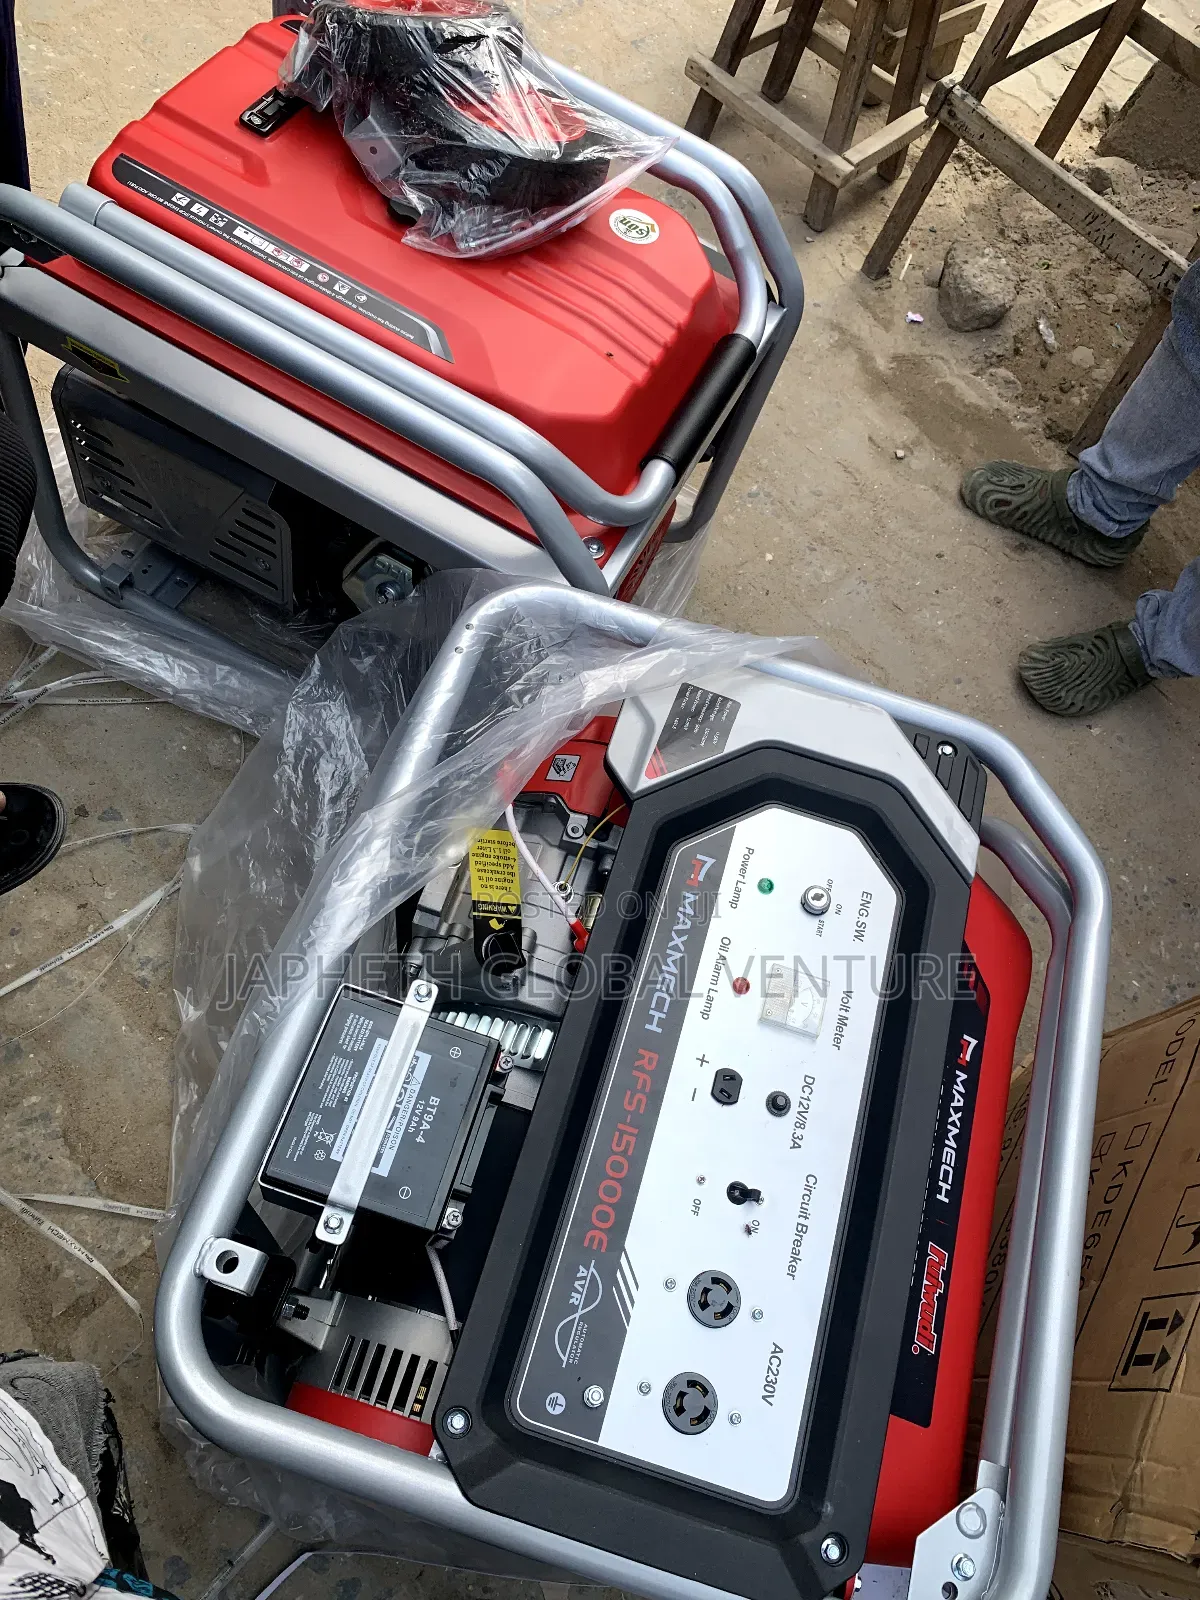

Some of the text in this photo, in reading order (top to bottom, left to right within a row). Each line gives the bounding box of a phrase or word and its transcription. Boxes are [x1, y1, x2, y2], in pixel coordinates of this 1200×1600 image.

[474, 860, 503, 868] specified
[730, 847, 755, 910] Power Lamp
[478, 903, 508, 913] WARNING
[815, 919, 825, 938] START
[834, 903, 843, 916] ON
[853, 890, 873, 943] ENG.SW.
[700, 935, 732, 1021] Oil Alarm Lamp
[831, 989, 855, 1052] Volt Meter
[583, 890, 698, 1253] MAXMECH RFS-15000E
[388, 1087, 415, 1151] DANGER/POISON
[407, 1099, 425, 1133] 12V 9Ah
[415, 1095, 440, 1144] BT9A-4
[789, 1073, 816, 1150] DC12V/8.3A
[936, 1069, 969, 1204] MAXMECH
[691, 1197, 761, 1234] OFF ON
[786, 1172, 818, 1281] Circuit Breaker
[568, 1264, 587, 1306] AVR
[568, 1321, 584, 1365] REGULATOR
[572, 1324, 589, 1365] AUTOMATIC
[761, 1341, 784, 1408] AC230V
